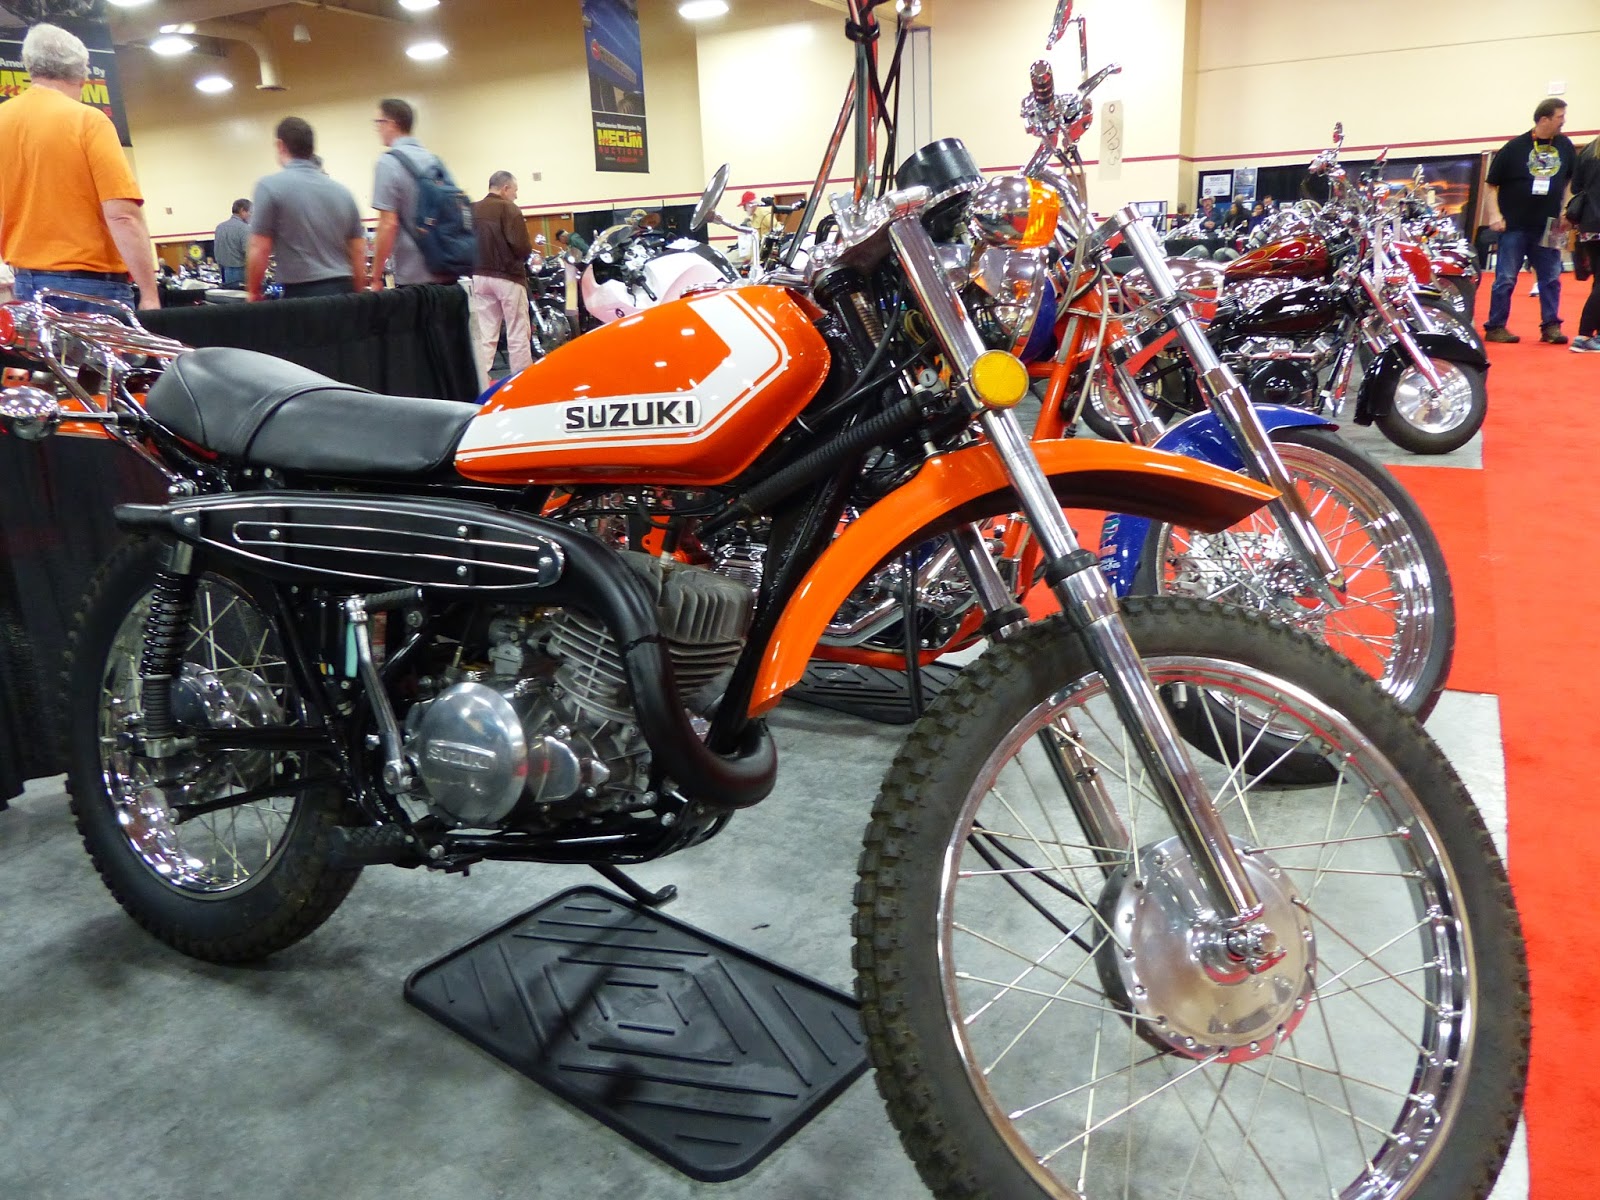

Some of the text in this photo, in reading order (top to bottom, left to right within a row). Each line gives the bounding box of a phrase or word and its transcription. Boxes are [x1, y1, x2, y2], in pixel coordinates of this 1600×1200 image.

[92, 66, 105, 78] By
[597, 129, 643, 148] MECUM
[566, 400, 694, 429] SUZUKI
[427, 746, 492, 770] SUZUKI
